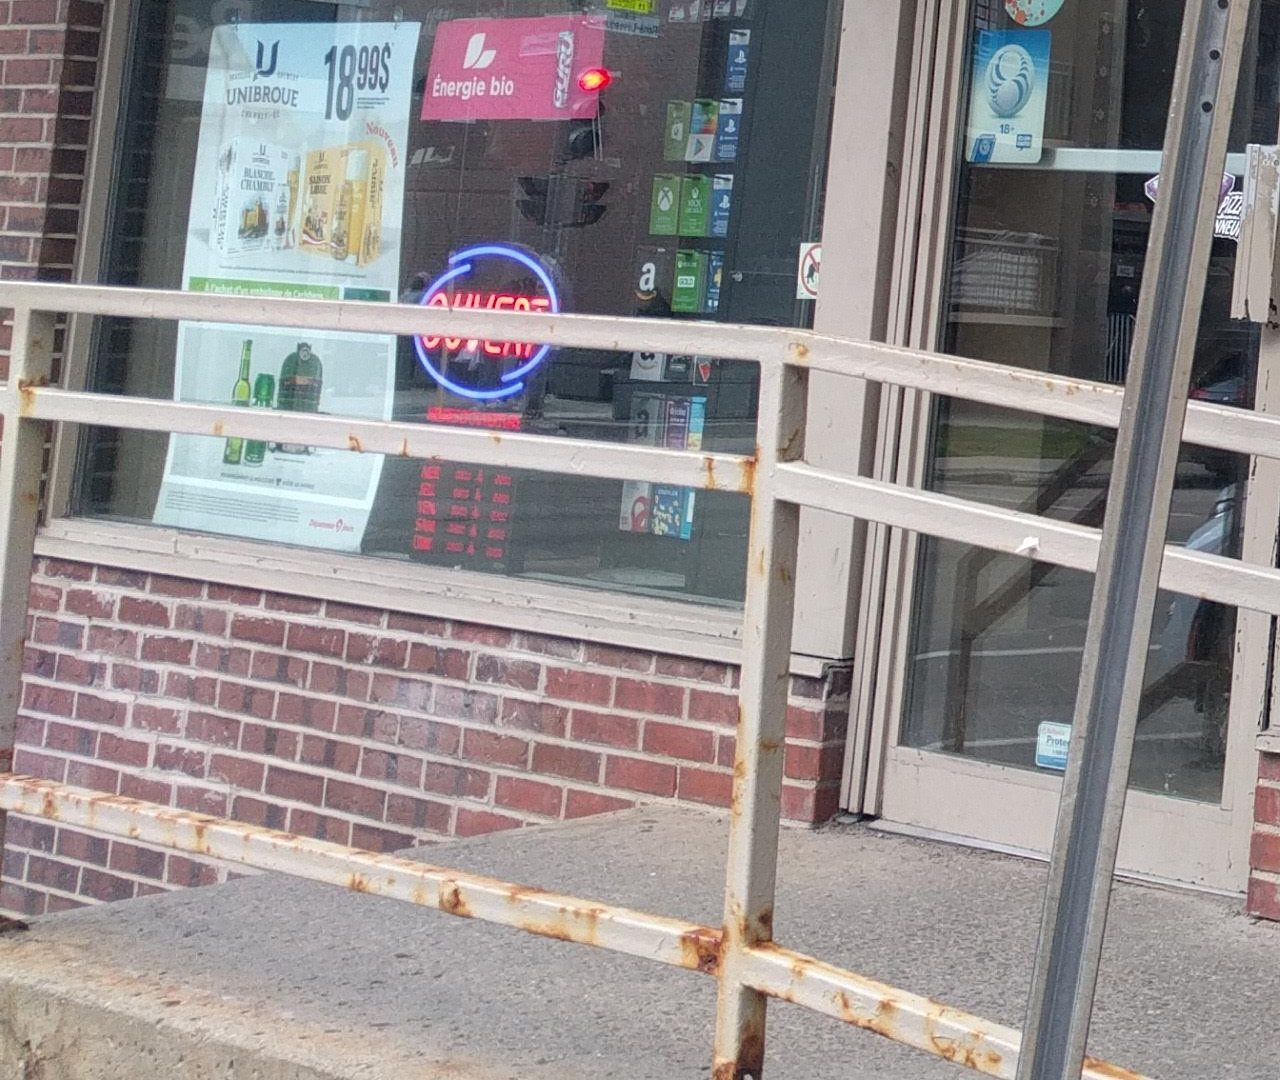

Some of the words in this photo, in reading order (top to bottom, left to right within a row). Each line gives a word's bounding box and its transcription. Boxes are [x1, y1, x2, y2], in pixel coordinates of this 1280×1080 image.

[553, 30, 575, 109] GURU
[226, 85, 300, 108] UNIBROUE
[432, 73, 486, 101] Énergie
[489, 76, 515, 96] bio
[1000, 123, 1016, 135] 18+
[1218, 193, 1243, 216] PIZZ
[1046, 734, 1069, 747] Prote
